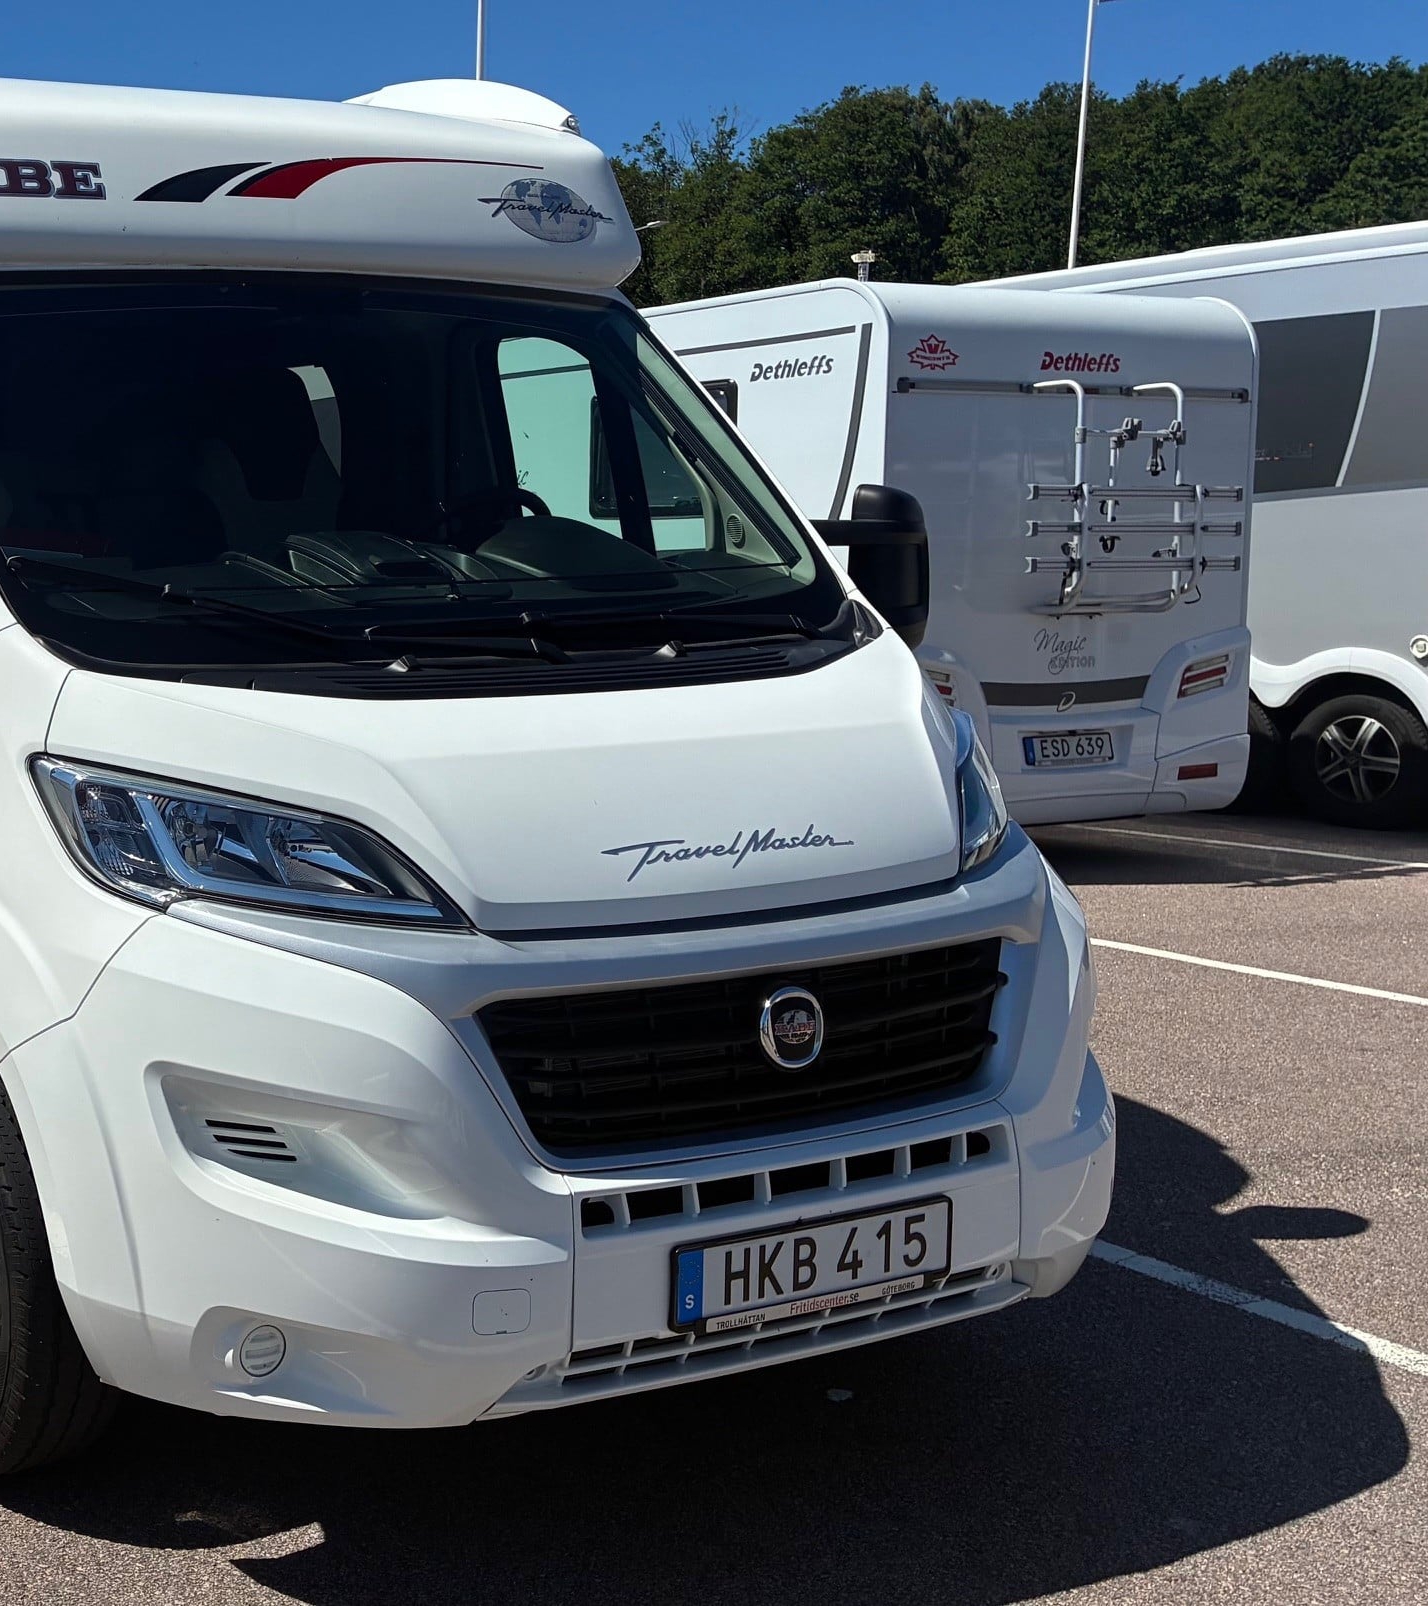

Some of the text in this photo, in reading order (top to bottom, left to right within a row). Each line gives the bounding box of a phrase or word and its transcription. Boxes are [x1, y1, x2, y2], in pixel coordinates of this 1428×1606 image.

[749, 354, 834, 382] Dethleffs
[1040, 351, 1121, 373] Dethleffs
[1033, 628, 1087, 675] Magic
[1040, 736, 1105, 758] ESD 639
[723, 1213, 927, 1306] HKB 415
[684, 1293, 695, 1310] S
[715, 1281, 916, 1330] TROLLHÄTTAN Fritidscenter.se GÖTEBORG
